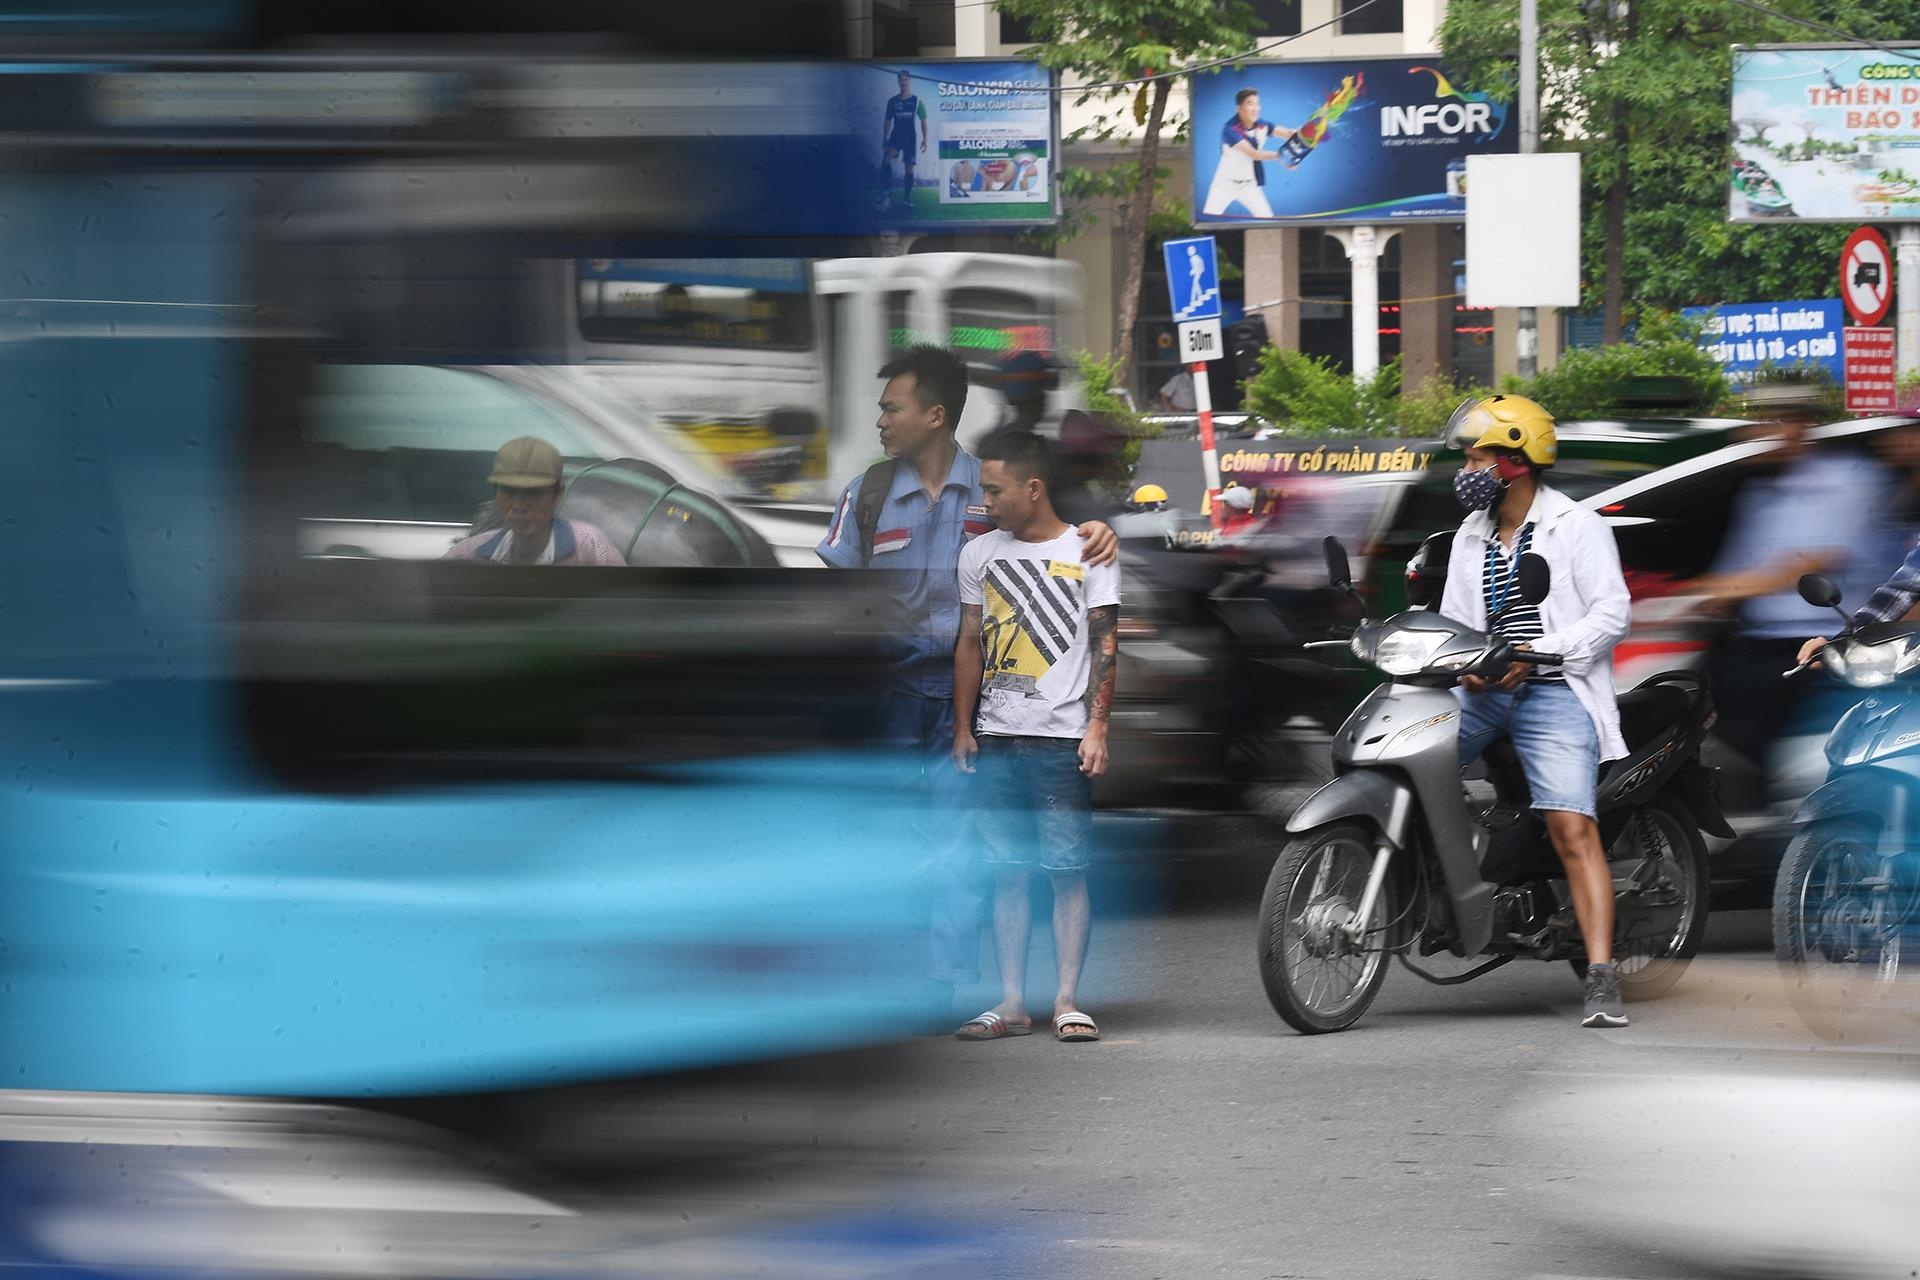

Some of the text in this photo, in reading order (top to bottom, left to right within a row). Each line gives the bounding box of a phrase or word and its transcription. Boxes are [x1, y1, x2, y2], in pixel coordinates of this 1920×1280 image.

[1861, 62, 1910, 80] CÔNG
[938, 80, 1013, 97] SALONSIP
[1809, 82, 1891, 105] THIÊN
[1381, 103, 1492, 136] INFOR
[1754, 306, 1780, 333] TRẢ
[1780, 308, 1825, 331] KHÁCH
[1190, 330, 1213, 352] 50m
[1220, 449, 1271, 473] CÔNG
[1272, 453, 1296, 472] TY
[1298, 445, 1327, 472] CỔ
[1325, 446, 1376, 472] PHẦN
[1377, 447, 1416, 472] BẾN
